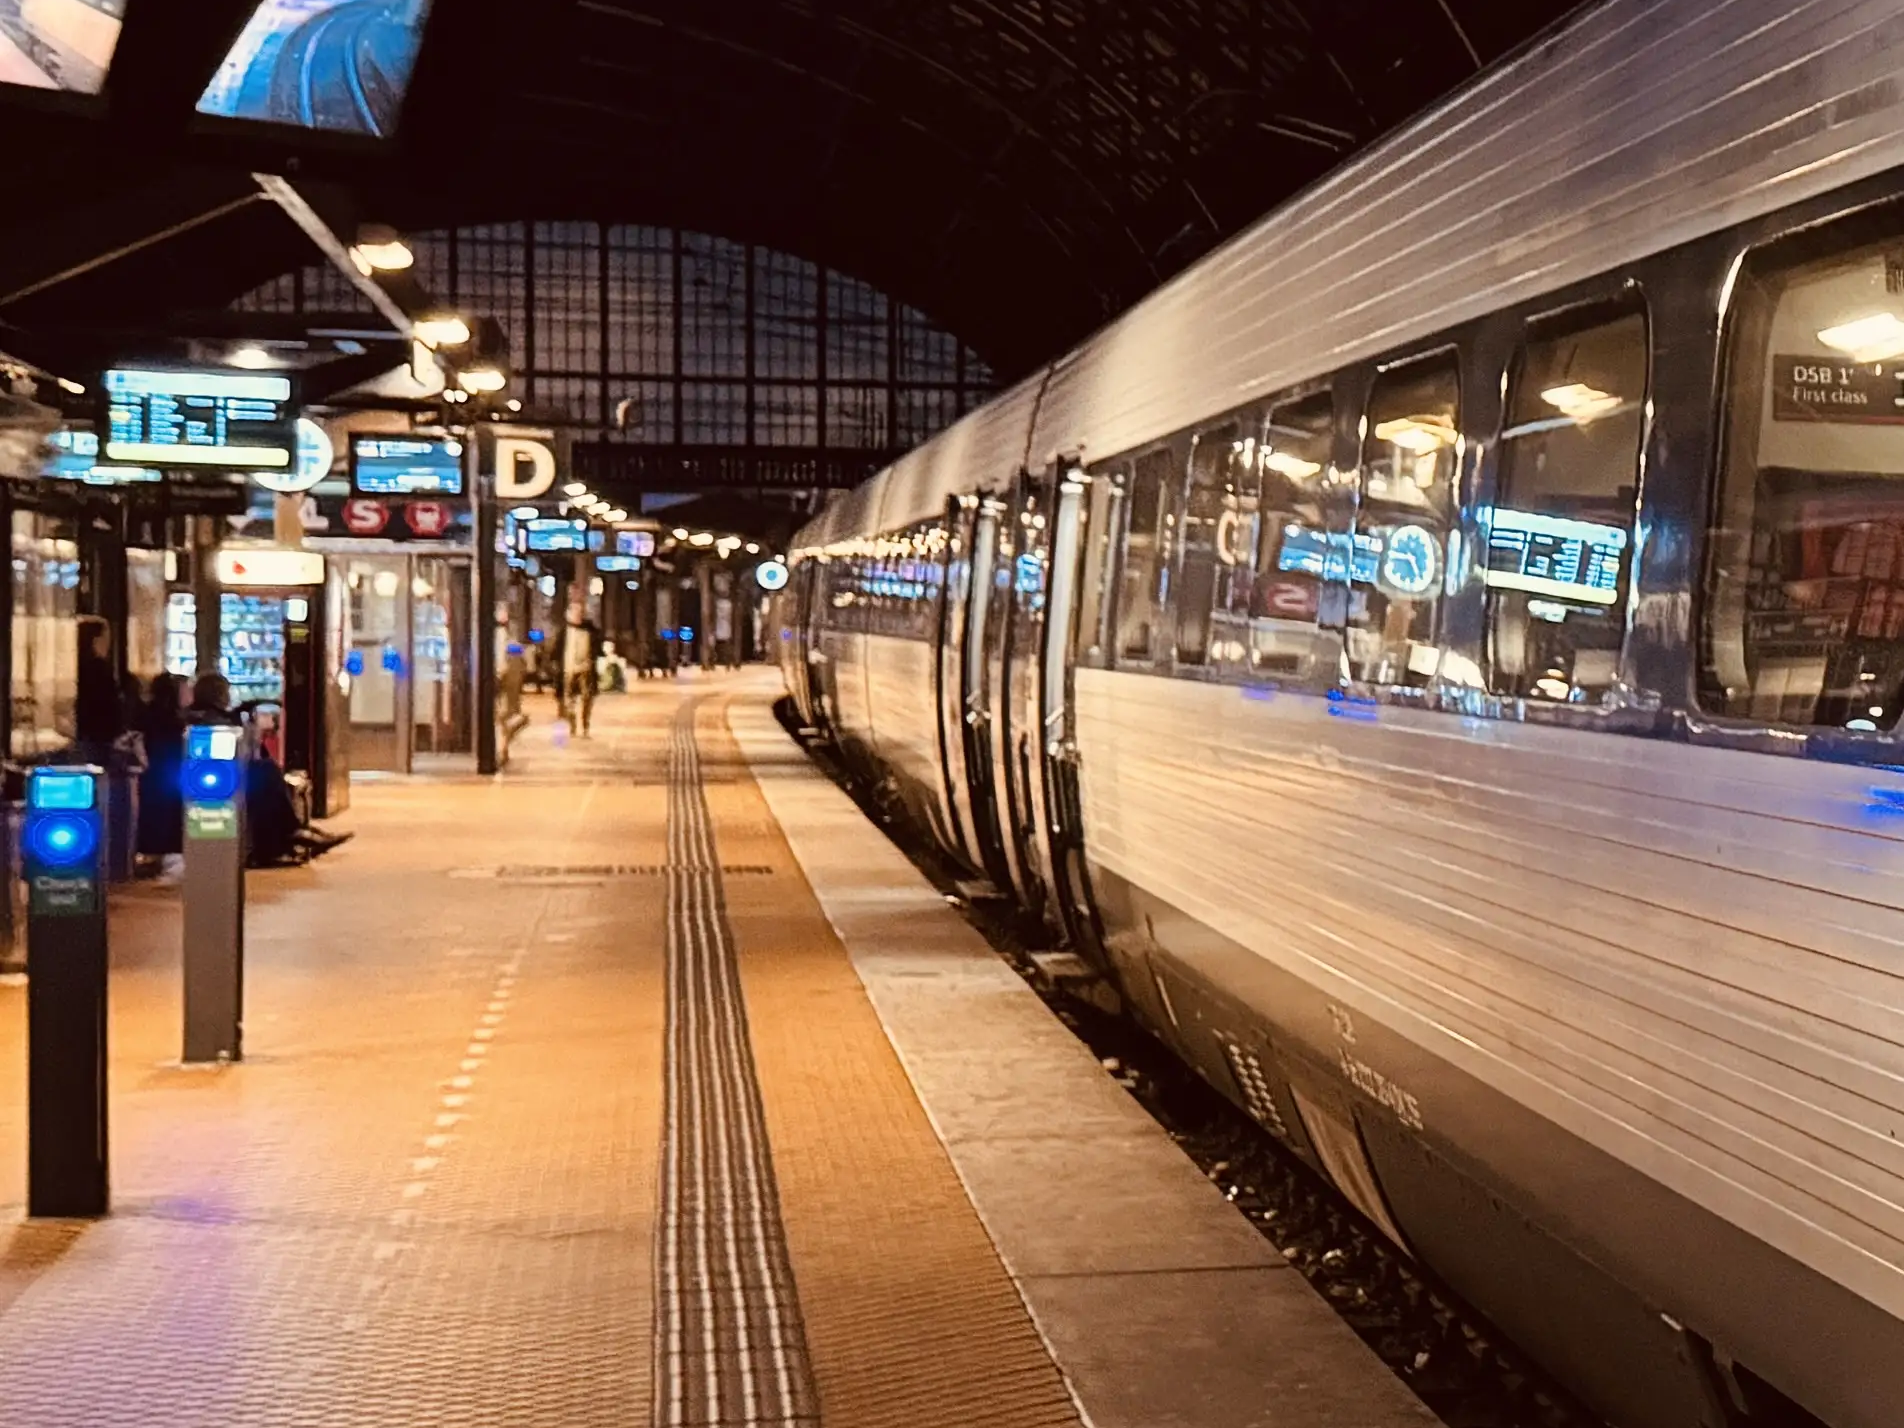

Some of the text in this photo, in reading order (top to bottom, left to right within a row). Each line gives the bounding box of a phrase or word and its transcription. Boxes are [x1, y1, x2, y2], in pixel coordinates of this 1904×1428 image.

[1794, 366, 1832, 385] DSB
[1793, 386, 1869, 405] First class
[495, 438, 556, 499] D
[351, 501, 382, 526] S
